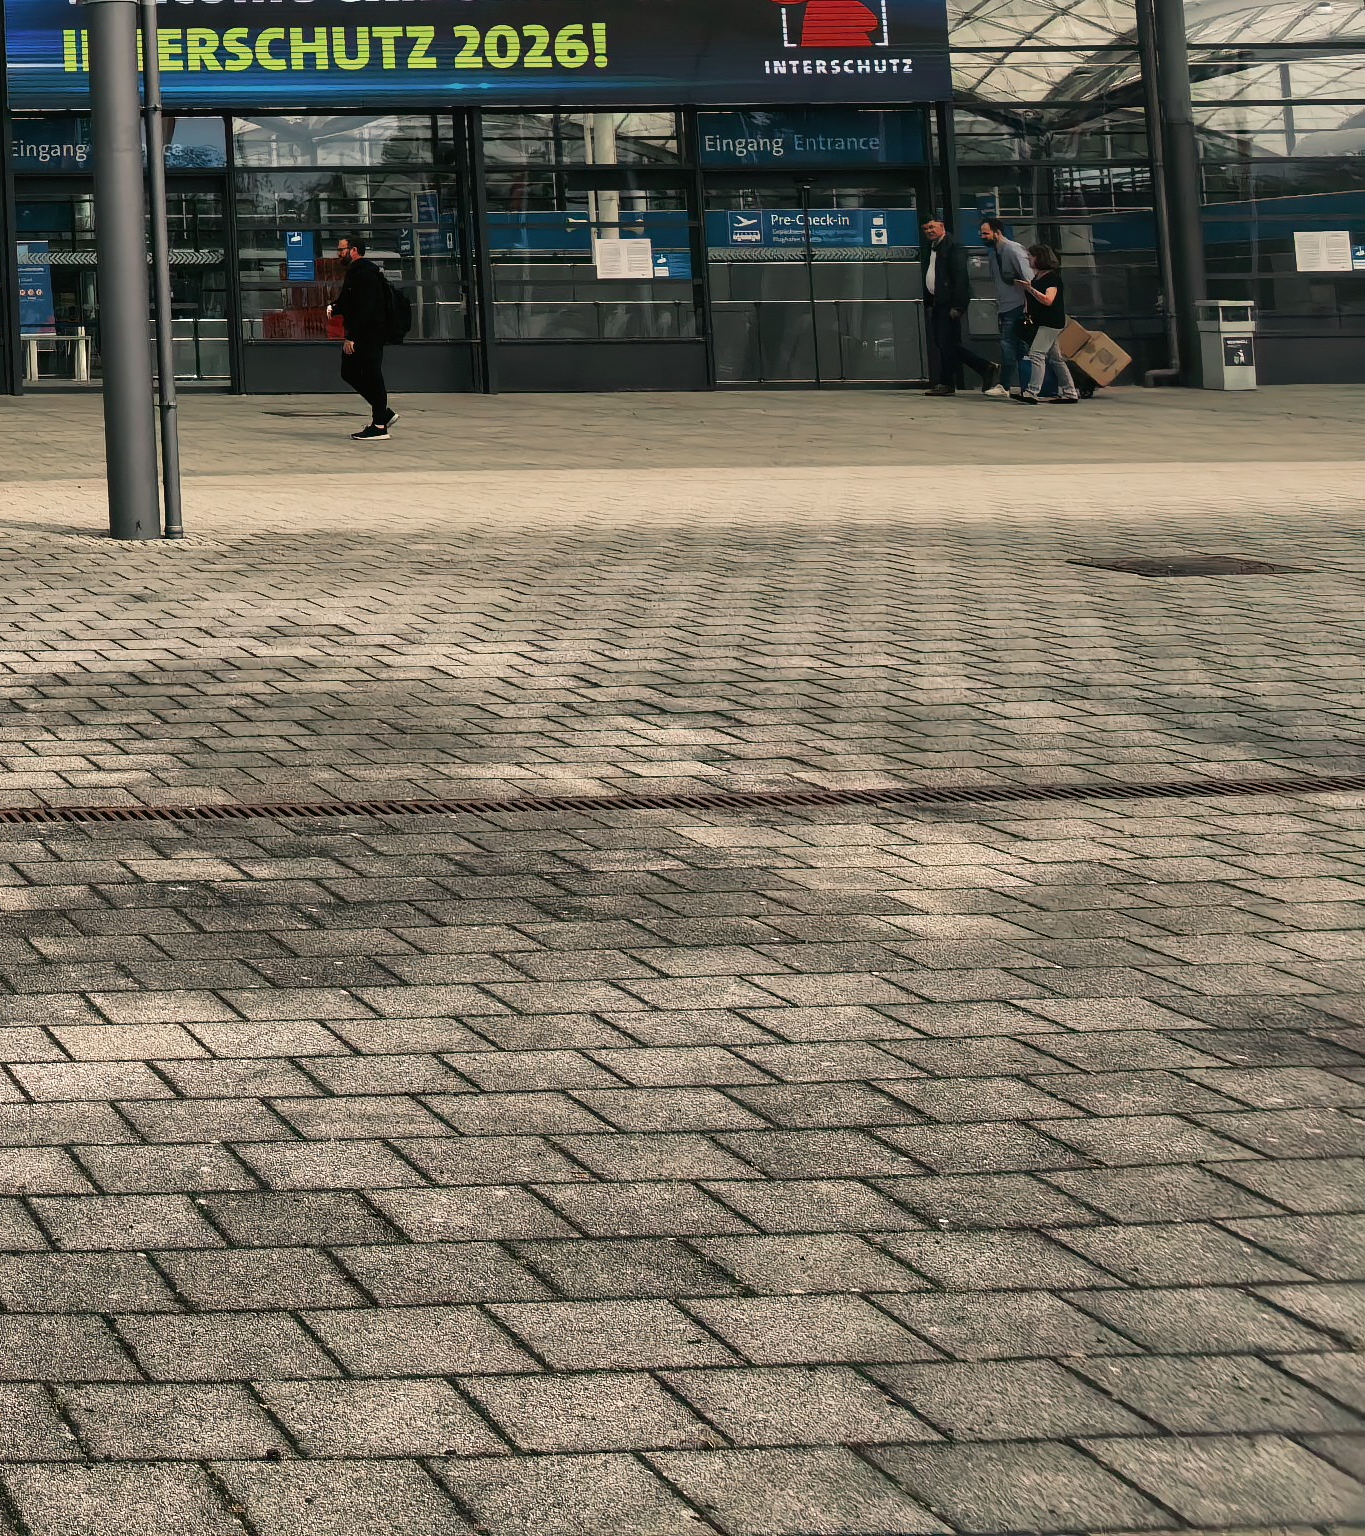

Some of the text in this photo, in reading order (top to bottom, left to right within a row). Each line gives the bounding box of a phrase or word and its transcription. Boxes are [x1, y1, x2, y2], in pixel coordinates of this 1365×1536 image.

[62, 22, 608, 72] IERSCHUTZ 2026!
[764, 58, 913, 75] INTERSCHUTZ
[12, 140, 87, 162] Eingang
[704, 134, 880, 156] Eingang Entrance
